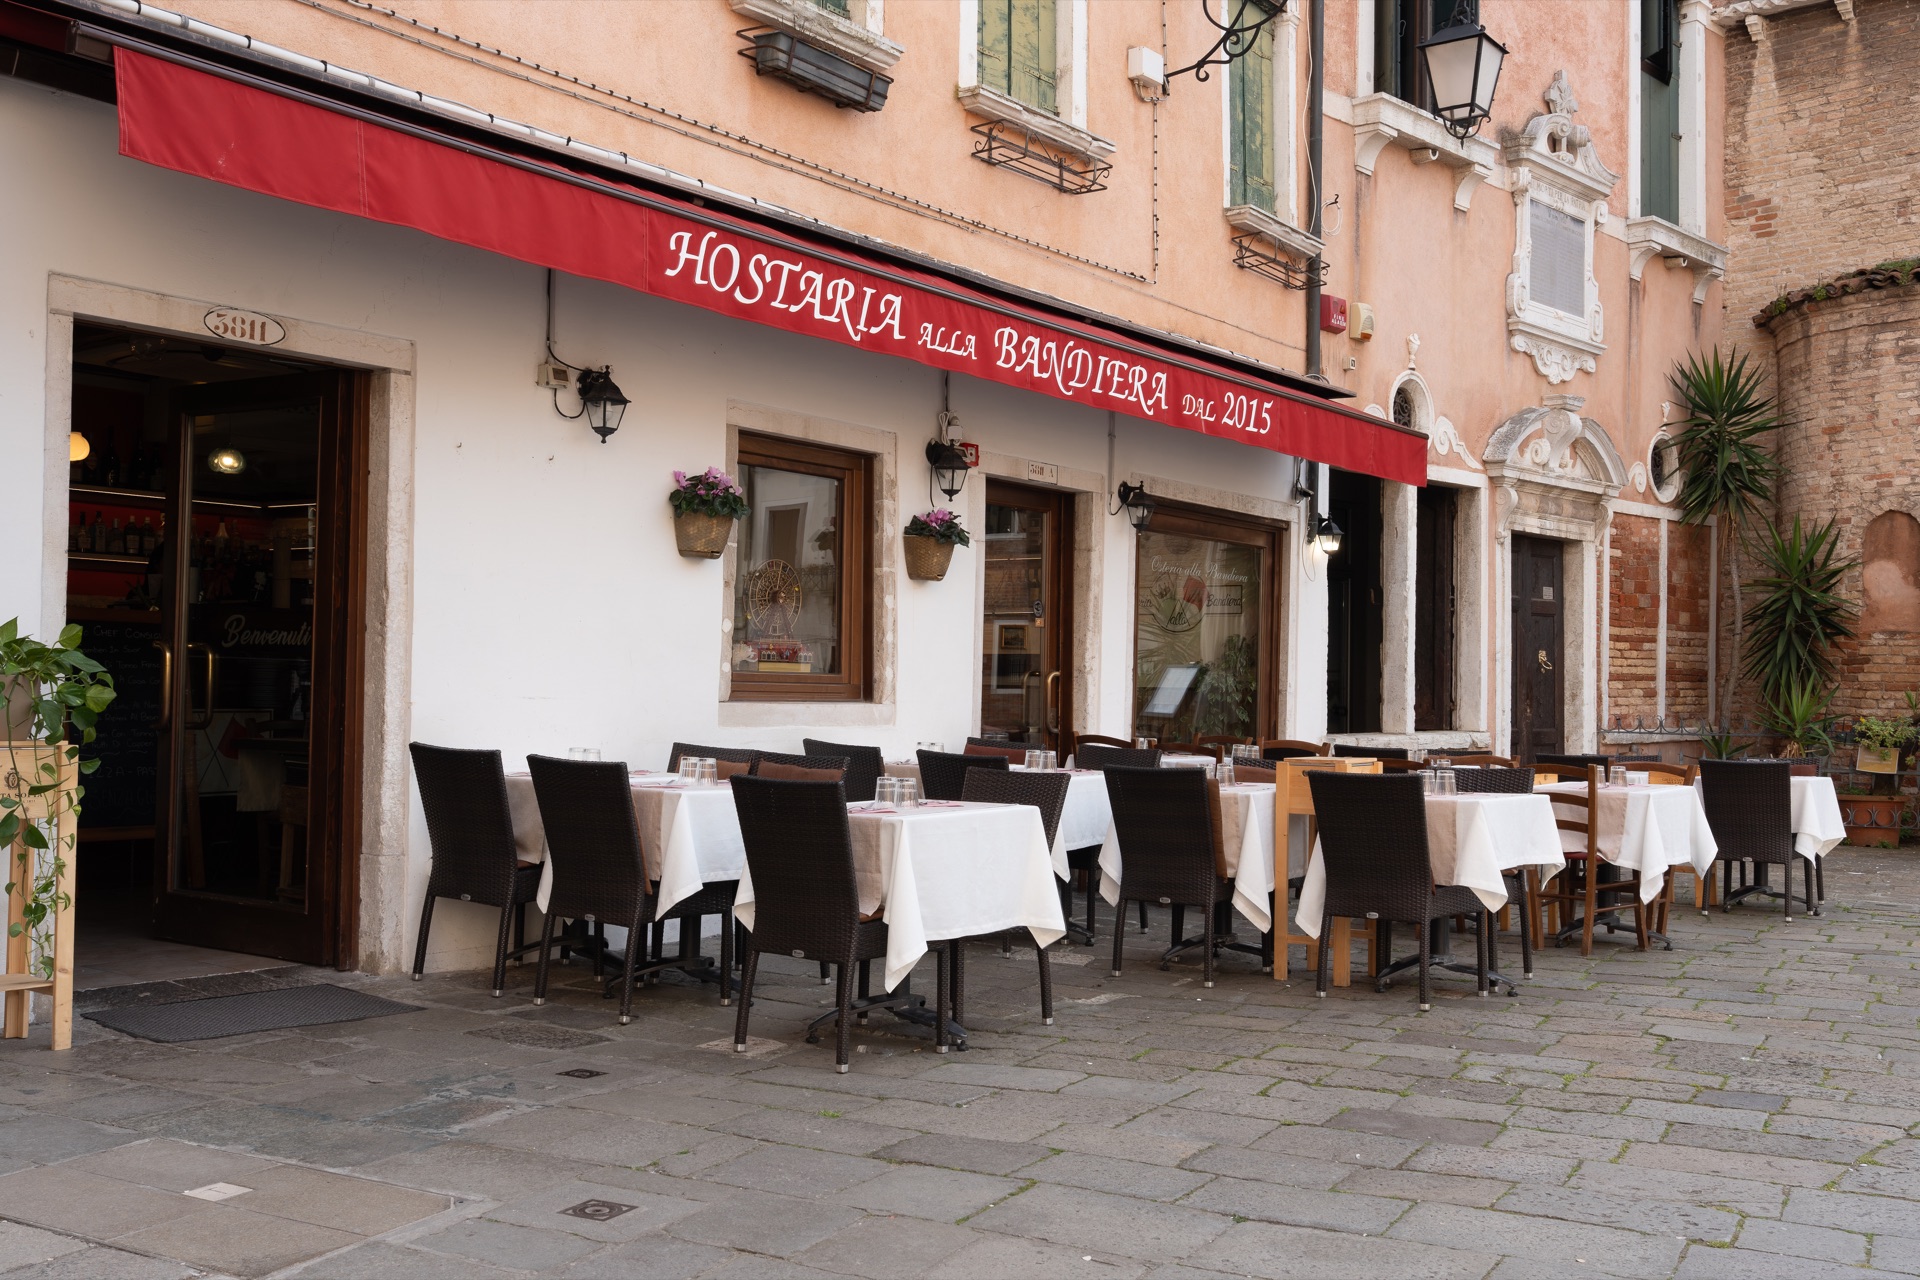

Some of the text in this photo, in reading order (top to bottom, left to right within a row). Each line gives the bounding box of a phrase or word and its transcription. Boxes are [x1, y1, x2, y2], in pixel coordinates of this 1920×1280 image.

[213, 312, 267, 342] 3811
[1333, 313, 1345, 322] FIRE
[664, 231, 1274, 435] HOSTARIA ALLA BANDIERA DAL 2015
[1184, 562, 1202, 577] alla
[1205, 563, 1249, 583] Bandiera
[221, 614, 312, 648] Benvenuti
